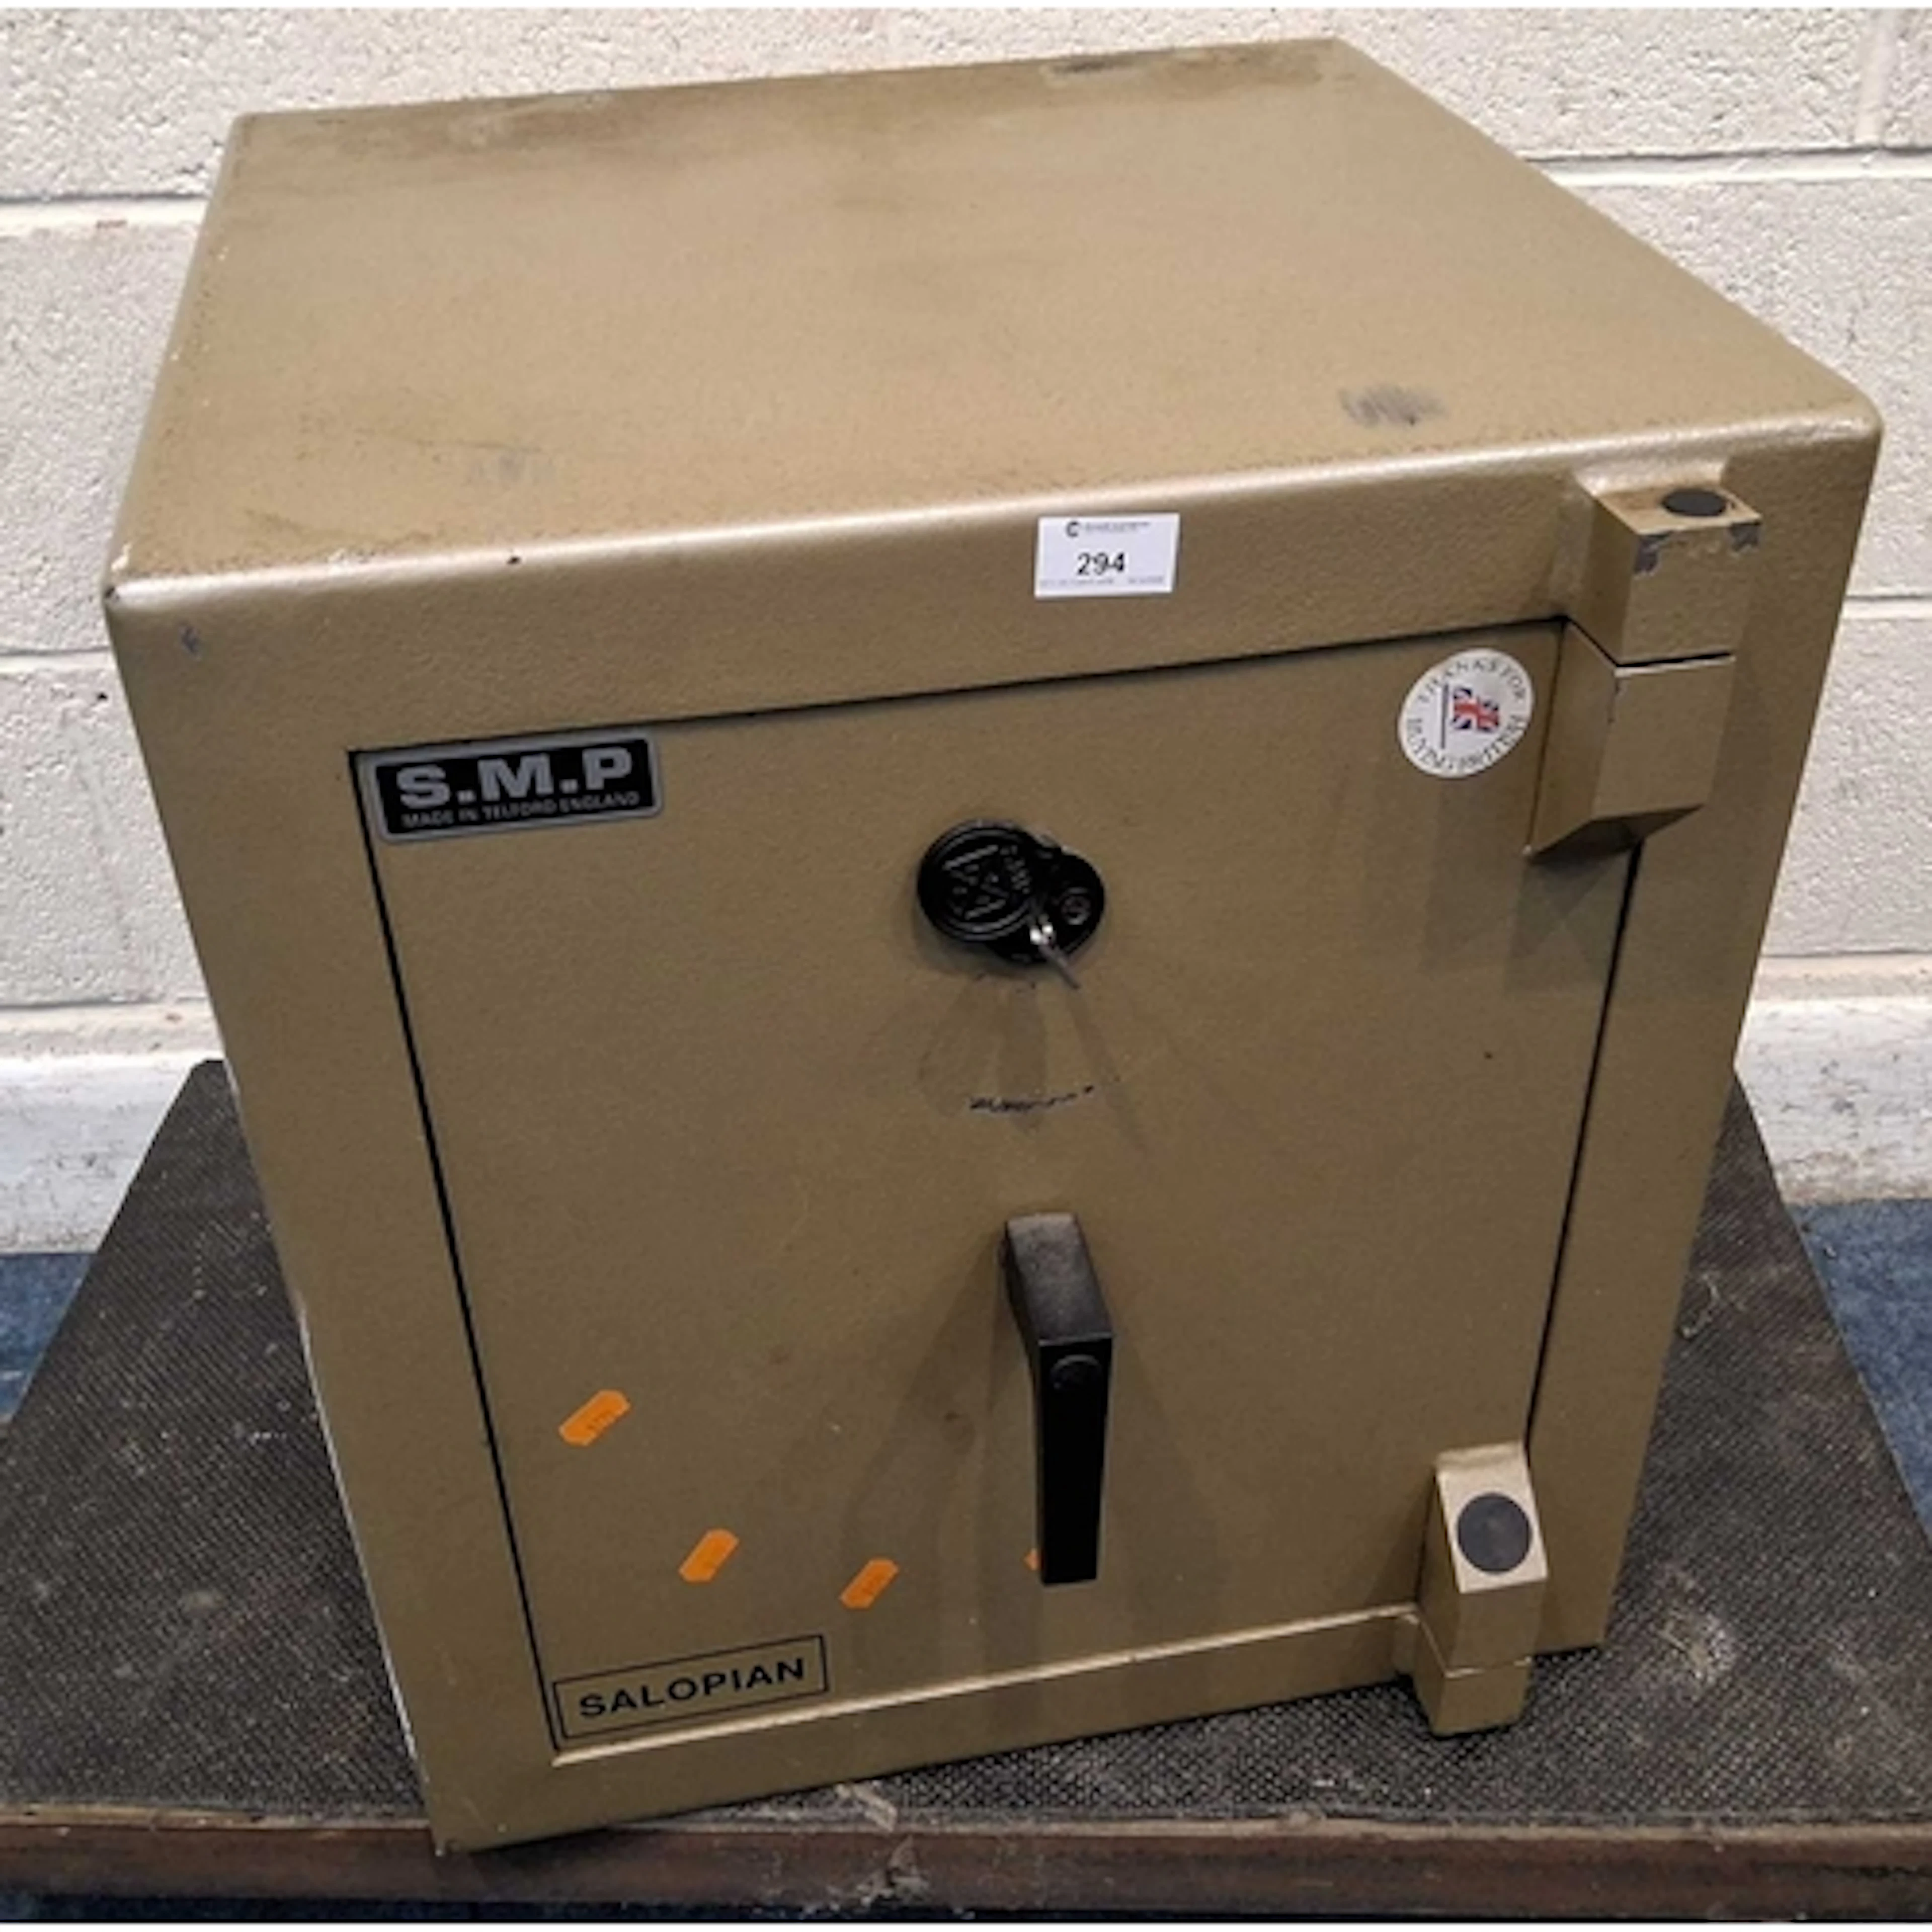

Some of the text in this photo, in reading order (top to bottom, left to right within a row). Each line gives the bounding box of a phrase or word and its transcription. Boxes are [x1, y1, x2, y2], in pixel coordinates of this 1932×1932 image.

[1077, 552, 1125, 576] 294
[396, 746, 632, 809] S.M.P
[458, 807, 478, 822] IN
[579, 1657, 803, 1717] SALOPIAN
